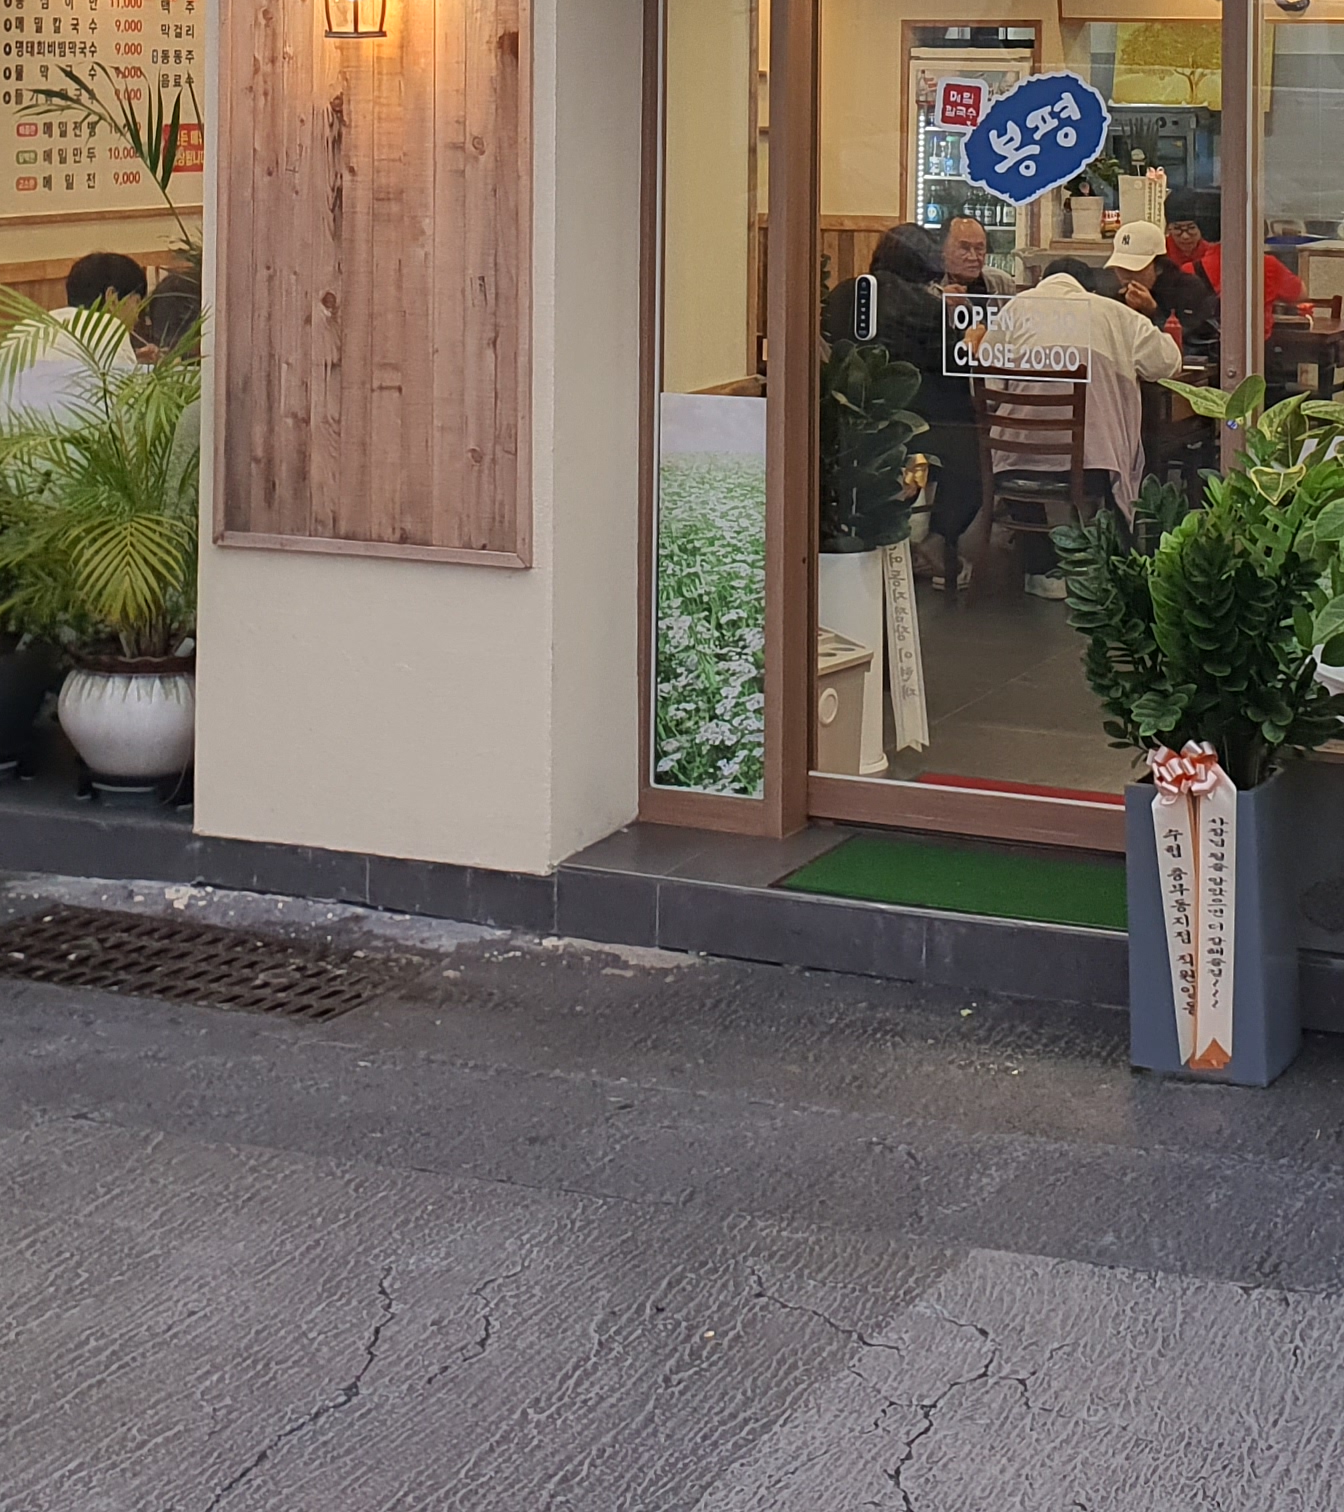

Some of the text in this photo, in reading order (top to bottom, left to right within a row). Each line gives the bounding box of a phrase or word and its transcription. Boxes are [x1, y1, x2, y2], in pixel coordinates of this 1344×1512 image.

[114, 19, 142, 33] 9,000
[114, 43, 142, 56] 9,000
[989, 92, 1081, 177] 봉평
[113, 172, 141, 185] 9,000
[954, 304, 1014, 331] OPEN
[954, 341, 1080, 371] CLOSE 20:00
